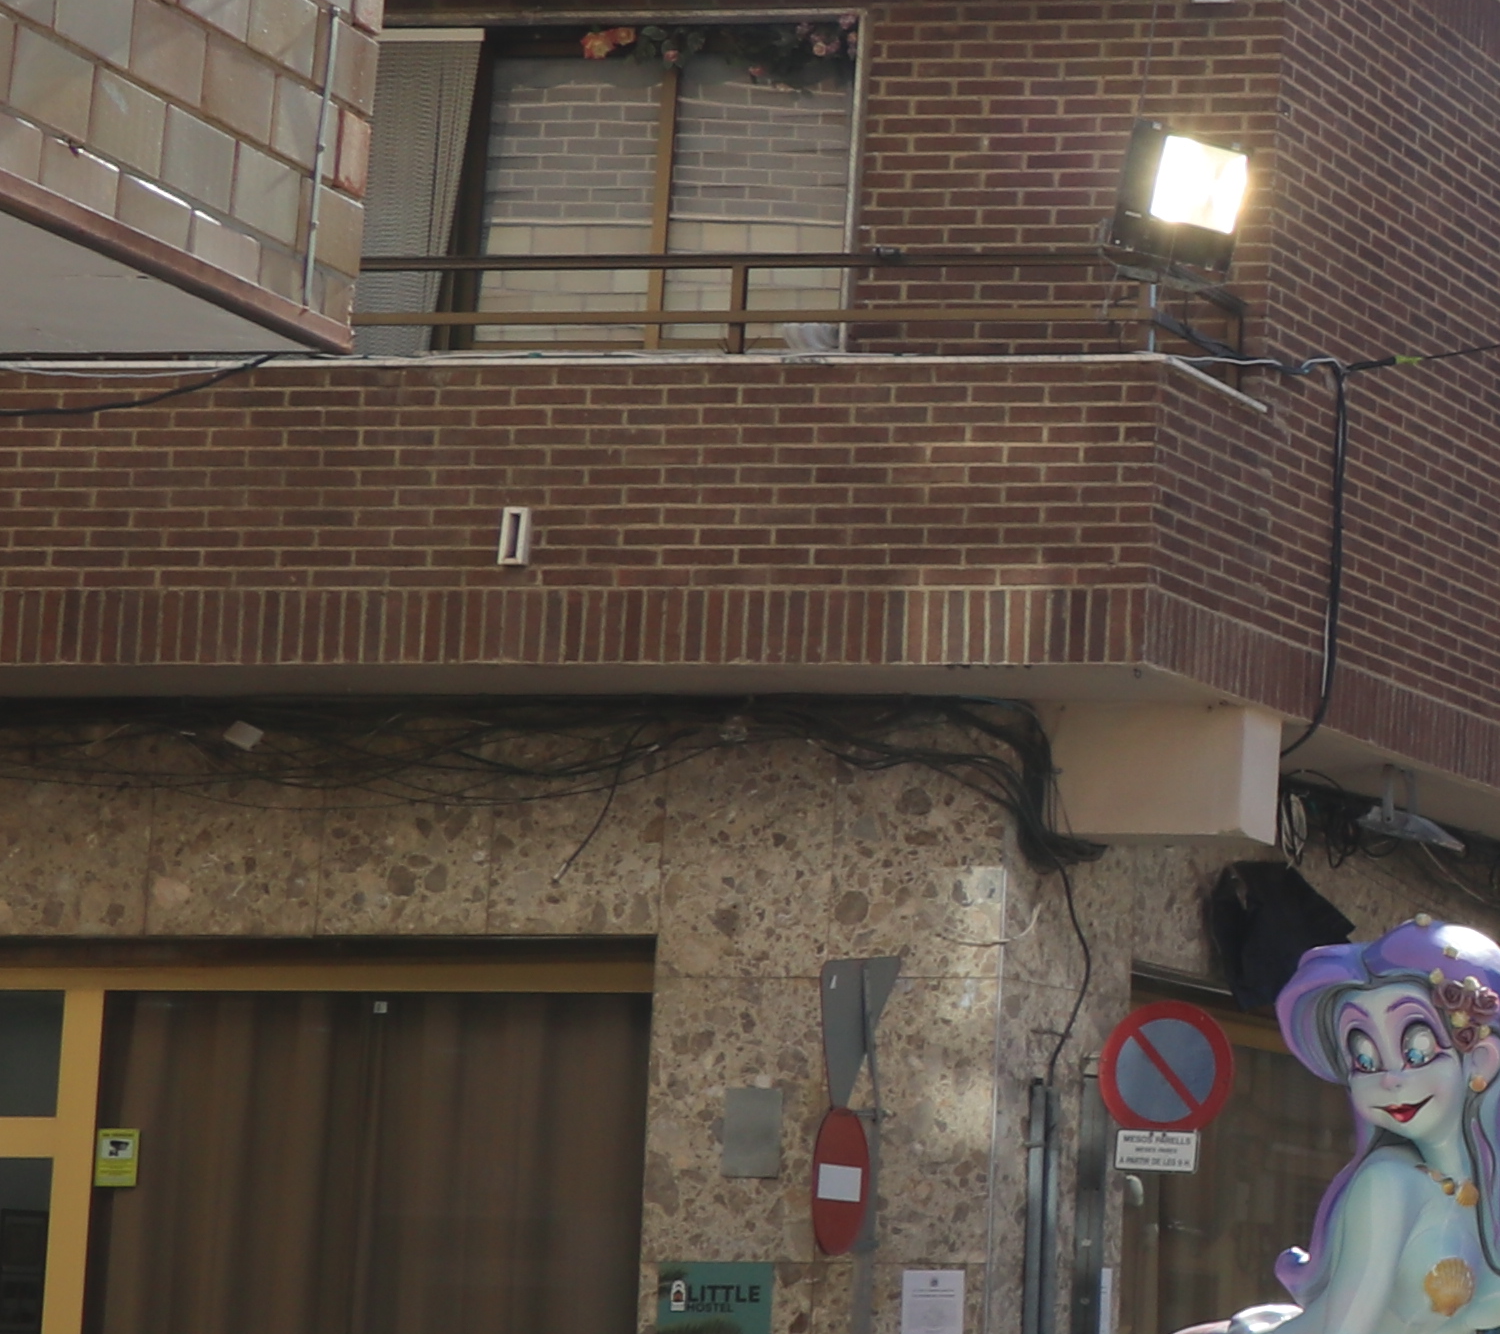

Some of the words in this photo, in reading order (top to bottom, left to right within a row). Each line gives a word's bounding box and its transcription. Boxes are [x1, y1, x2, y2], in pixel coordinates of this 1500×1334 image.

[1123, 1134, 1153, 1144] MESOS
[1155, 1135, 1192, 1145] PARELLS
[687, 1285, 761, 1304] LITTLE
[687, 1303, 734, 1314] HOSTEL
